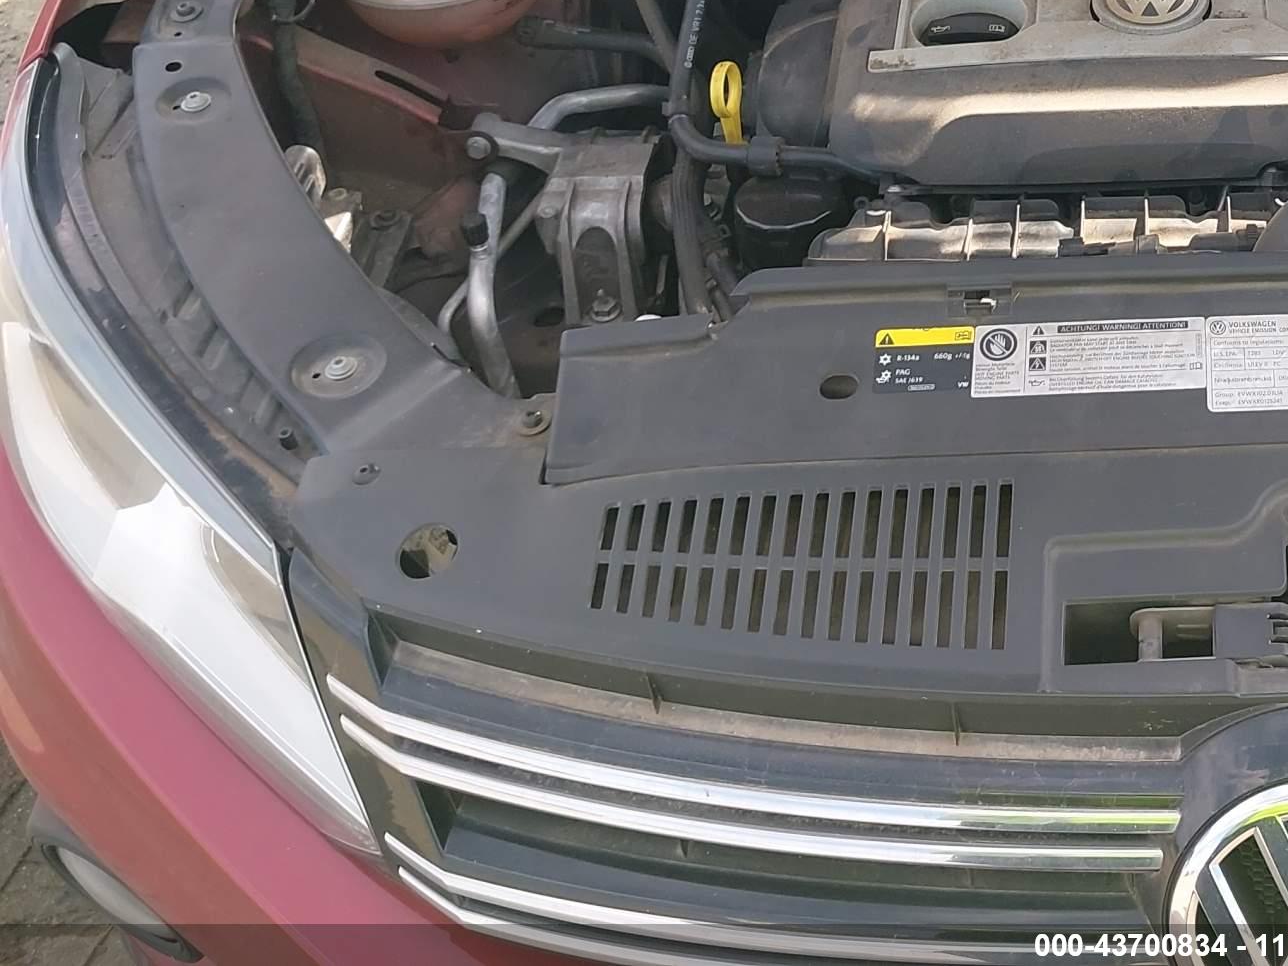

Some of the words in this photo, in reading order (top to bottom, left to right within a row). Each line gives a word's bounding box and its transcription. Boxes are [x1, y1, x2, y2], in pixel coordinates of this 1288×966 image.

[1102, 322, 1141, 332] WARNING!
[1142, 320, 1187, 330] ATTENTION!
[1228, 320, 1277, 328] VOLKSWAGEN
[895, 368, 911, 376] PAG
